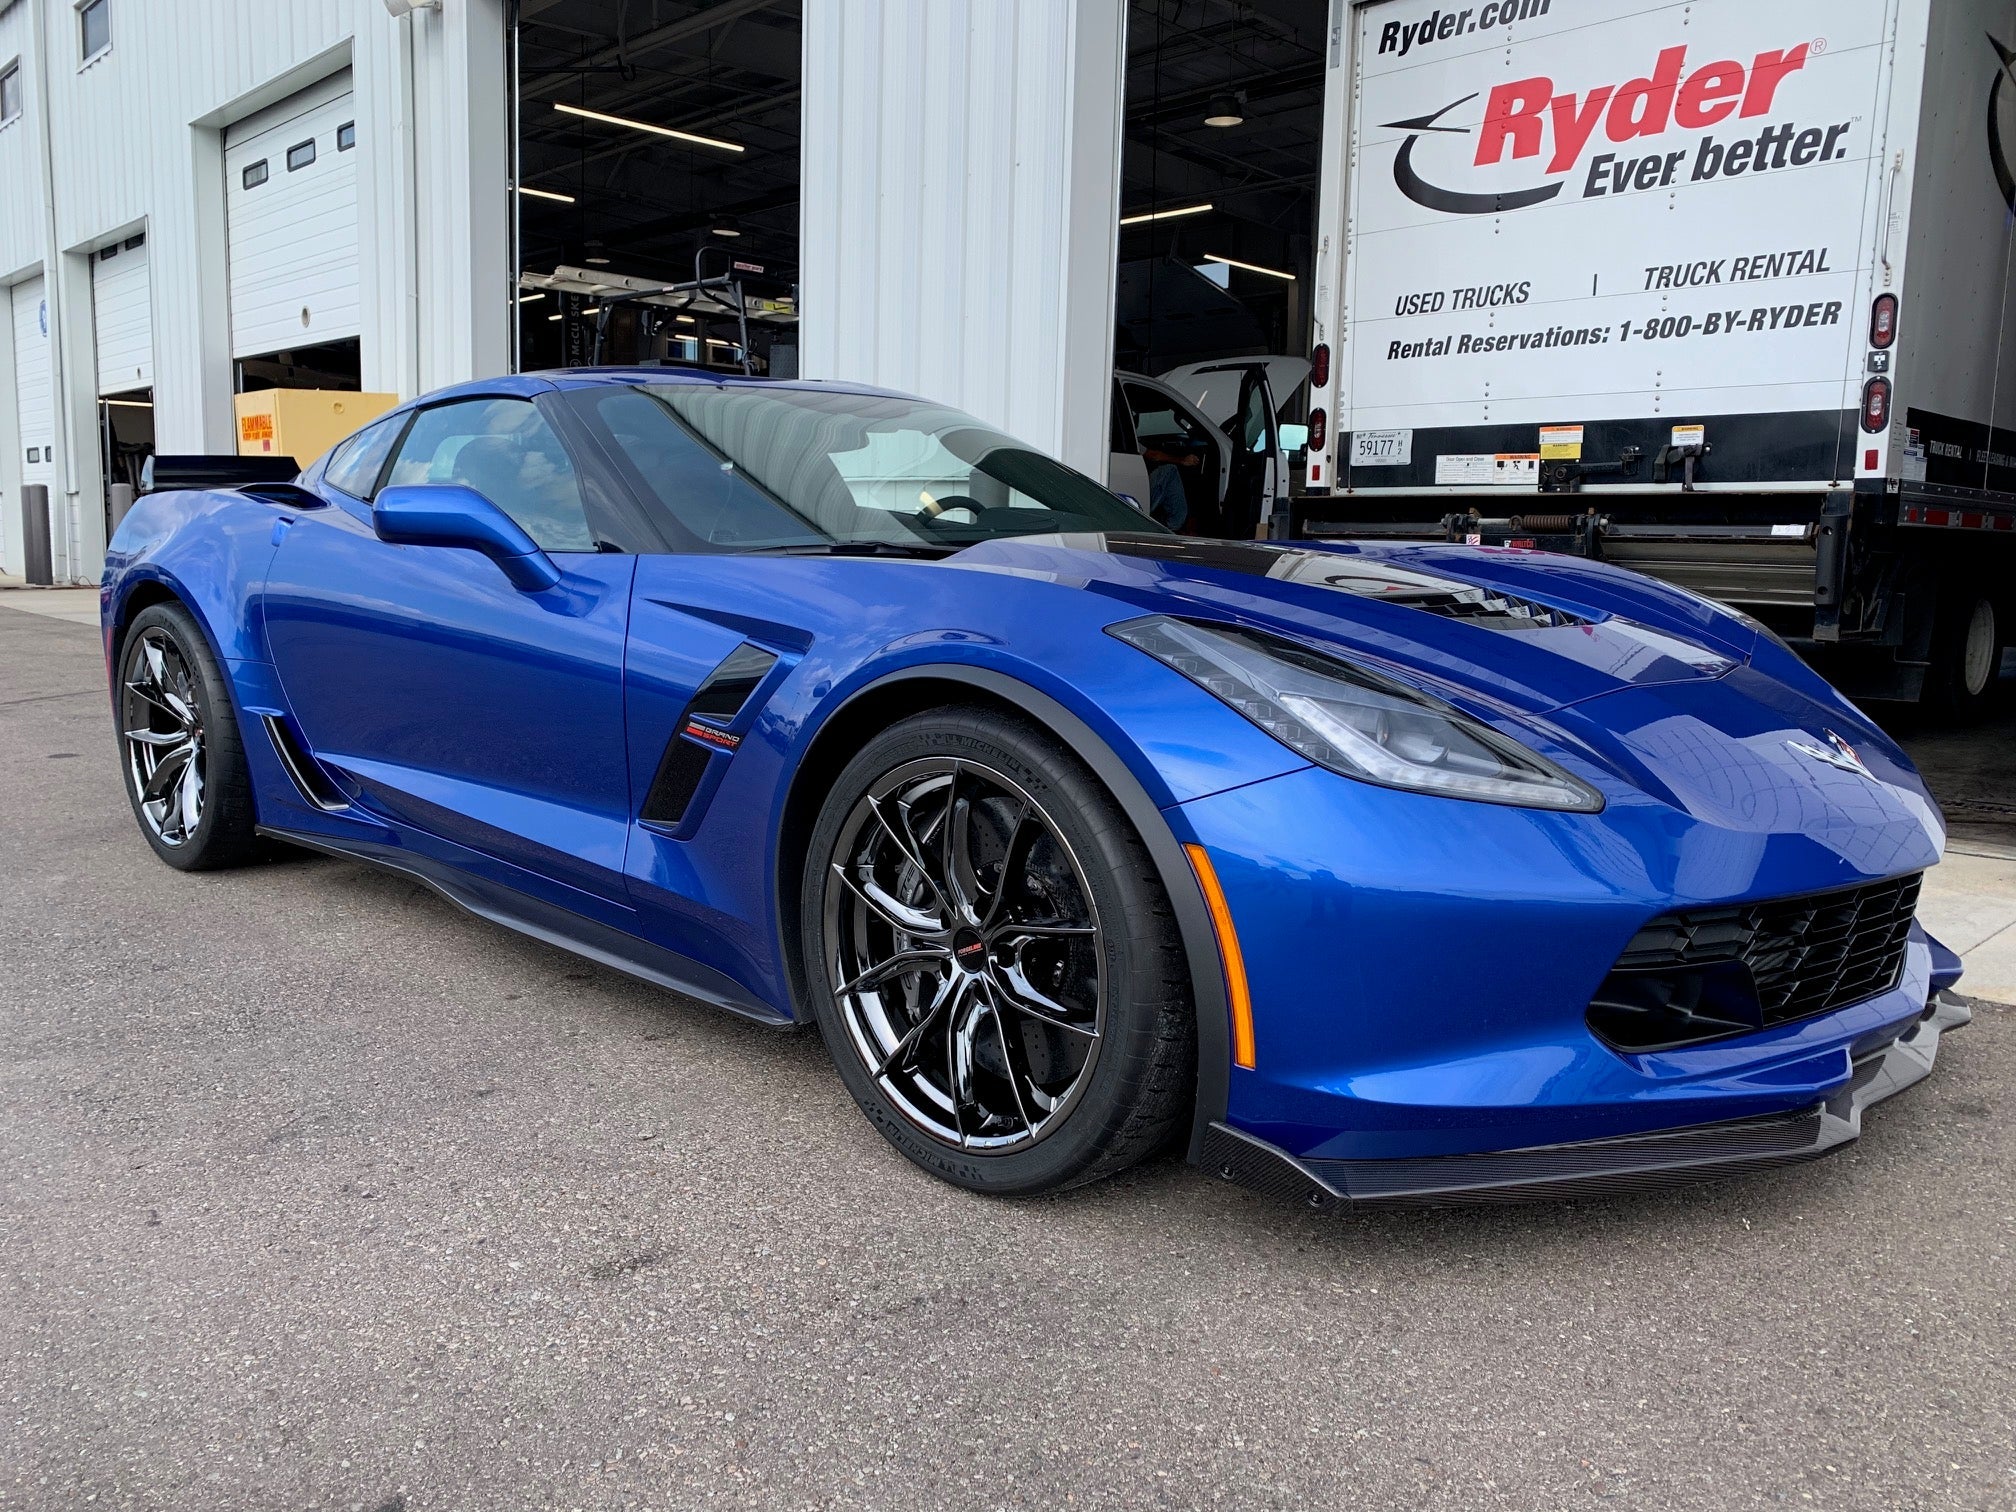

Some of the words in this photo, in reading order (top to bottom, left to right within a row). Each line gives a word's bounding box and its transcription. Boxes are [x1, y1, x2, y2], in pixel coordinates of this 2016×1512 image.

[1378, 0, 1550, 57] Ryder.com
[1473, 44, 1810, 175] Ryder
[1582, 149, 1686, 198] Ever
[1690, 121, 1850, 182] better.
[1645, 259, 1726, 290] TRUCK
[1730, 248, 1830, 282] RENTAL
[1395, 291, 1445, 316] USED
[1452, 281, 1531, 310] TRUCKS
[1387, 334, 1452, 360] Rental
[1456, 326, 1611, 354] Reservations:
[1620, 301, 1843, 343] 1-800-BY-RYDER
[1360, 439, 1394, 456] 59177
[1930, 440, 1945, 456] TRUCK
[1945, 442, 1962, 459] RENTAL
[702, 732, 738, 747] SPORT
[705, 727, 740, 743] GRAND
